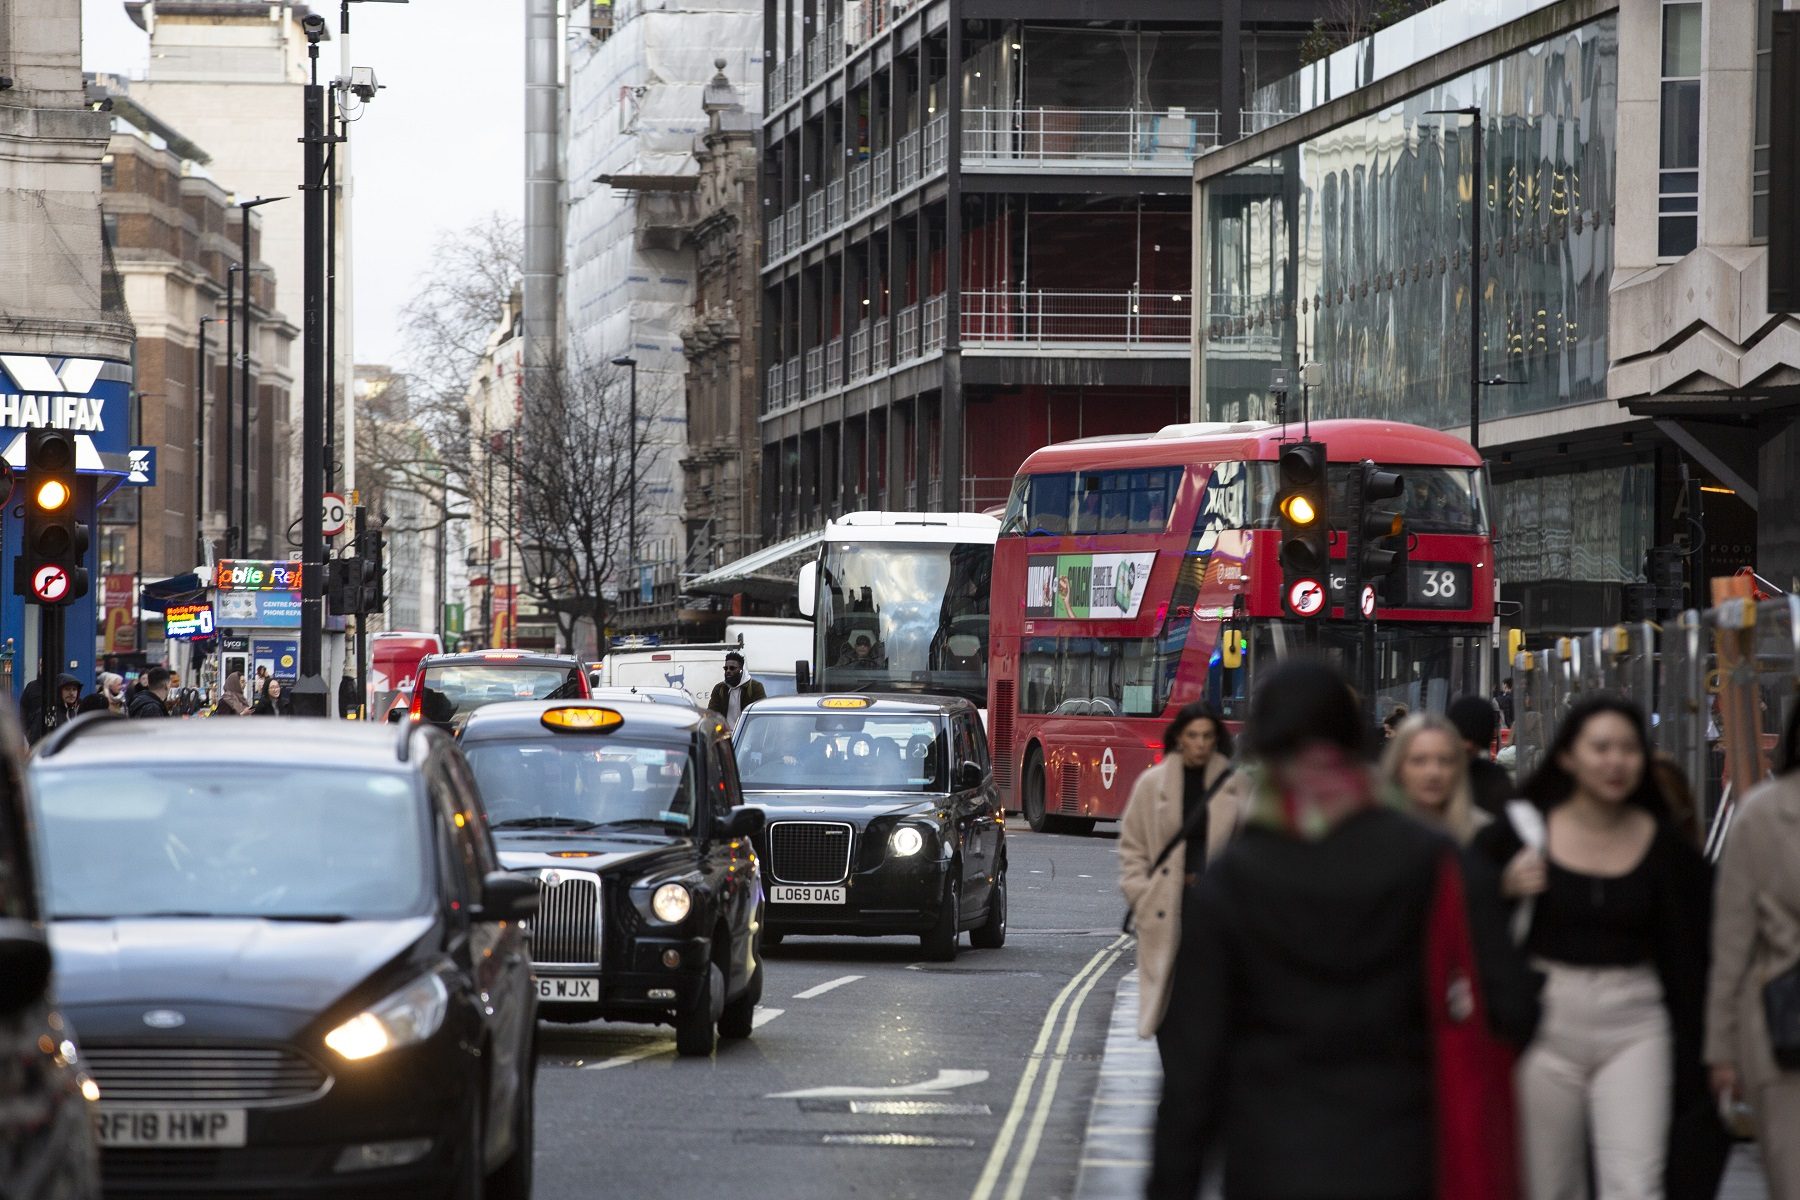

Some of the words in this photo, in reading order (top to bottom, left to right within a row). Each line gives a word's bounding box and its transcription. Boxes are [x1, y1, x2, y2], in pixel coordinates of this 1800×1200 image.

[0, 393, 104, 431] HALIFAX
[322, 506, 344, 522] 20
[1422, 570, 1456, 598] 38
[223, 640, 242, 648] Lyca
[558, 709, 604, 725] TAXI
[776, 888, 811, 901] LO69
[814, 889, 840, 902] OAG
[556, 980, 590, 997] WJX
[167, 1112, 229, 1141] HWP
